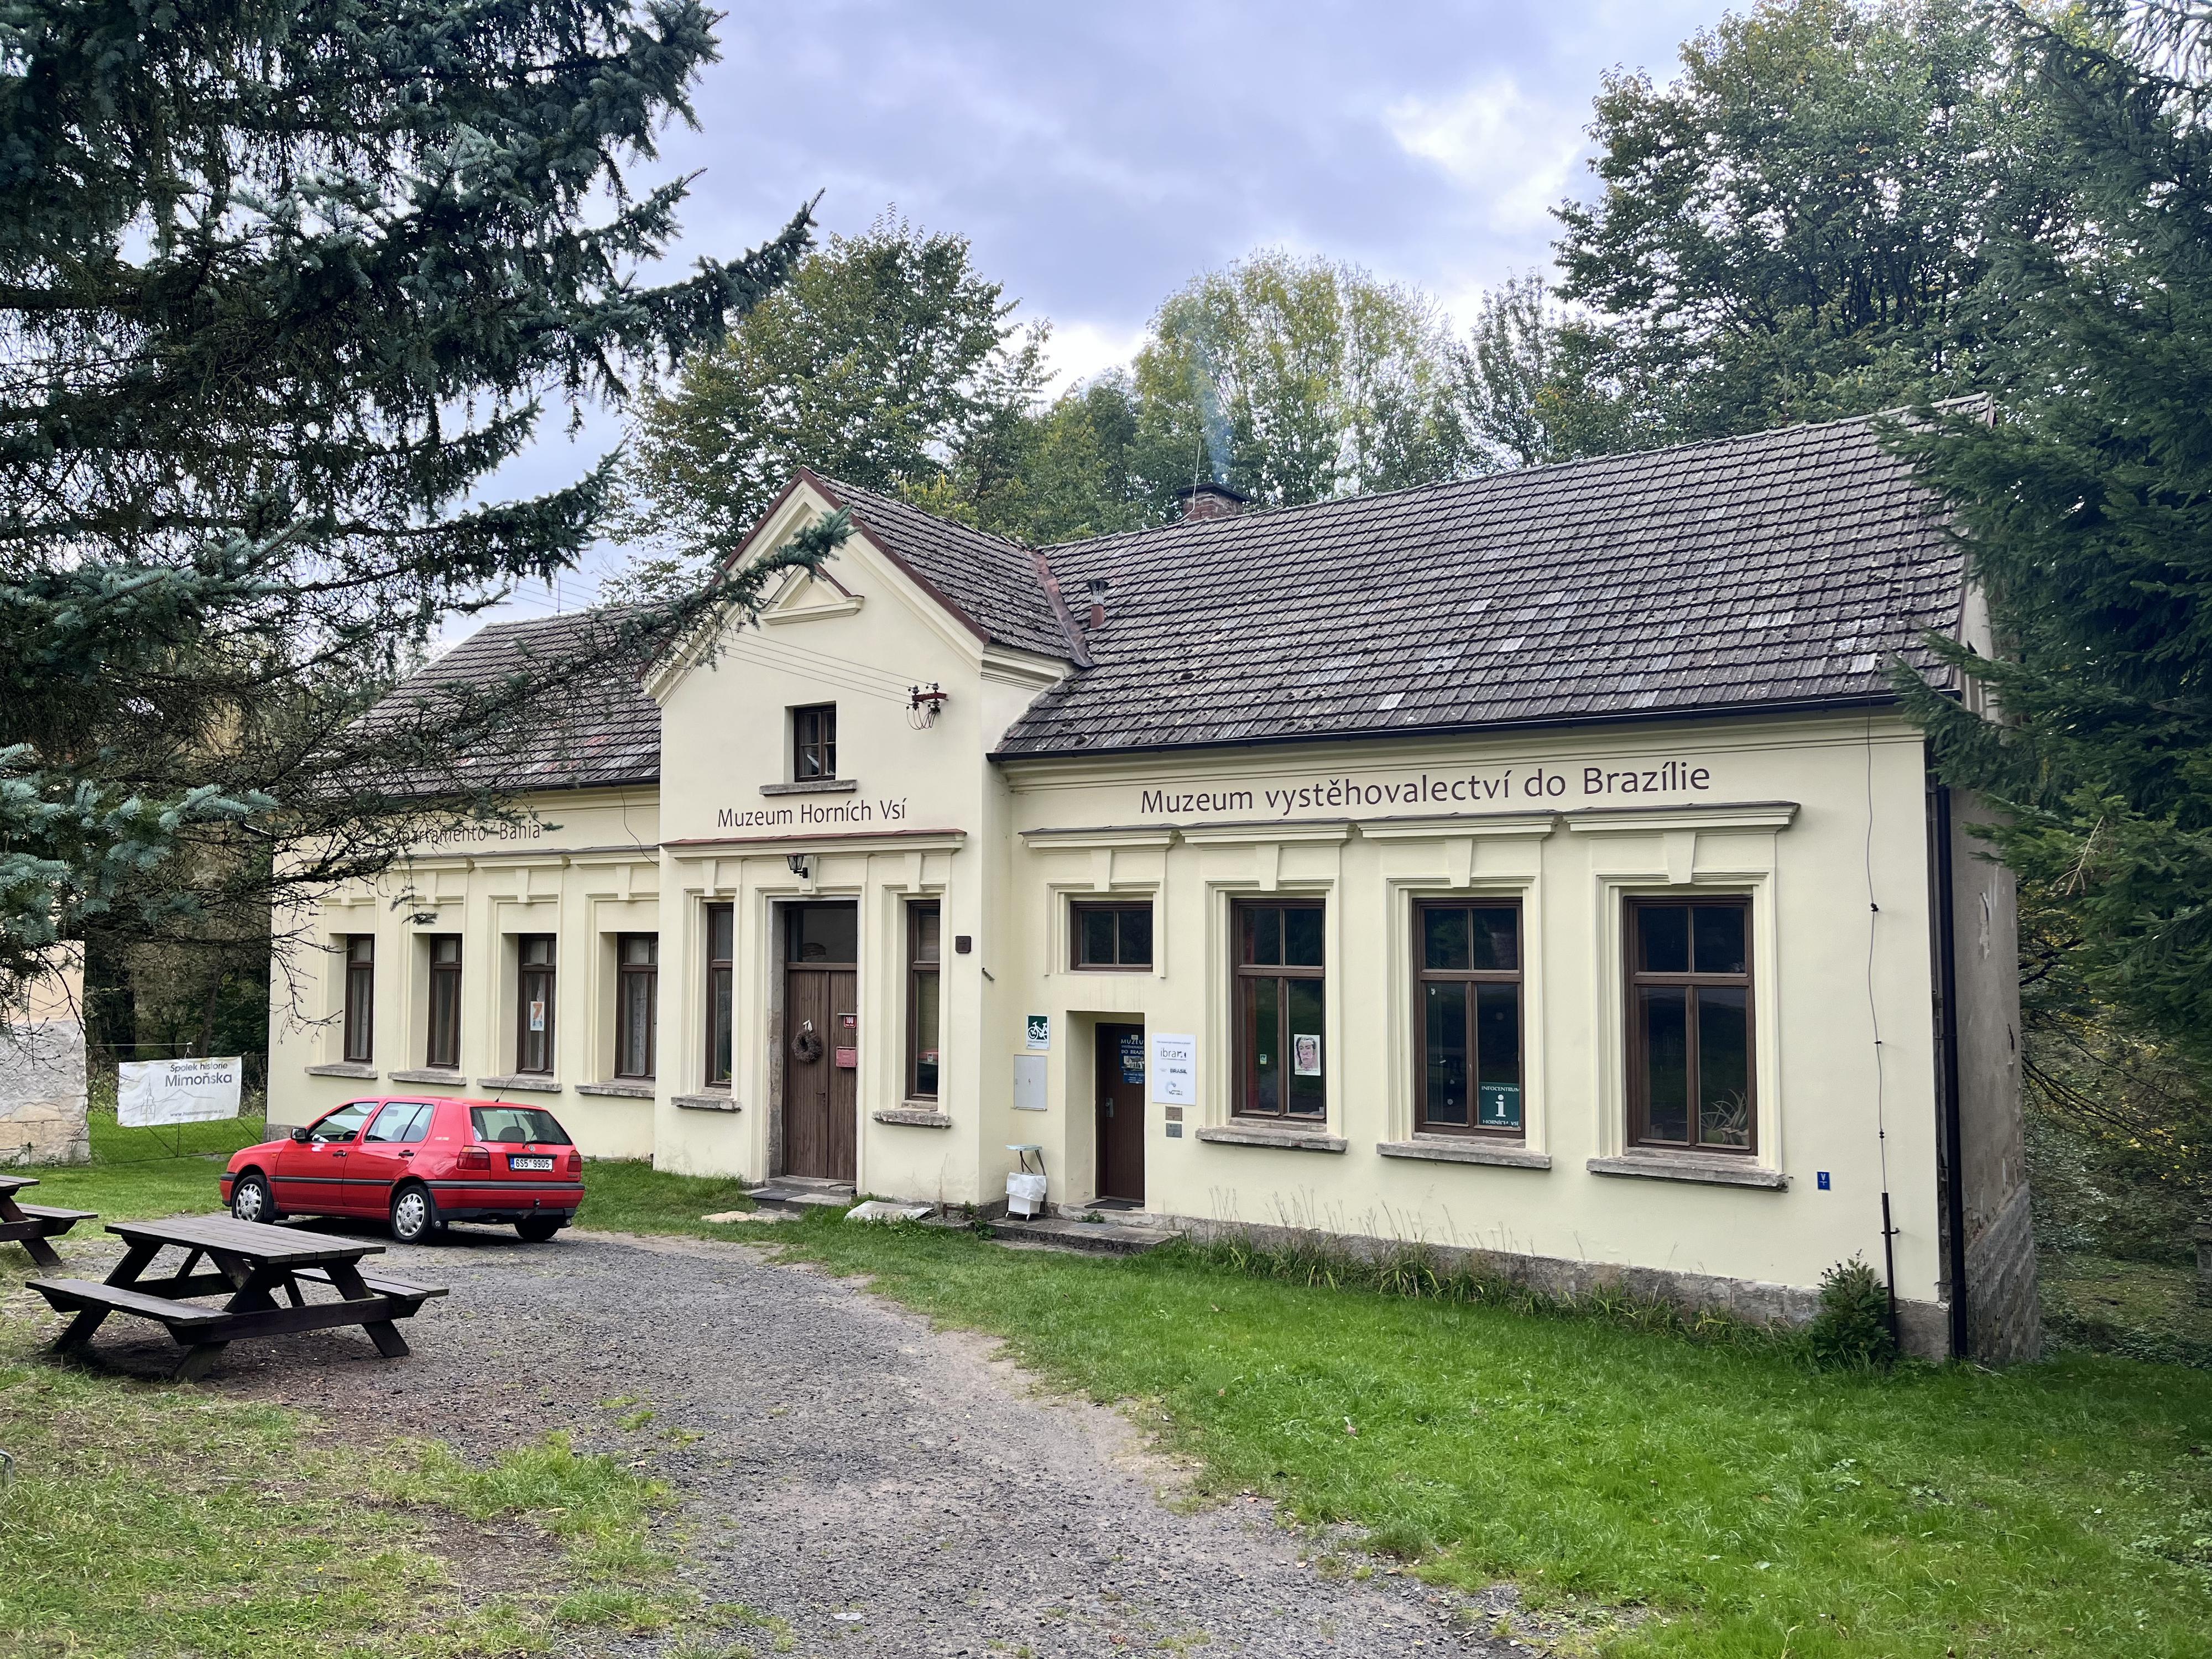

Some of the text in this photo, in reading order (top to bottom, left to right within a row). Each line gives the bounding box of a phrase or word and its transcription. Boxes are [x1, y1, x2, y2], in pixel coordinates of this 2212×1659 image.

[1141, 761, 1709, 816] Muzeum vystěhovalectví do Brazílie
[718, 797, 907, 827] Muzeum Horních Vsí
[499, 820, 540, 839] Bahia
[170, 1063, 197, 1073] Spolek
[165, 1072, 232, 1087] Mimoňska
[515, 1159, 549, 1168] 6S5 9905
